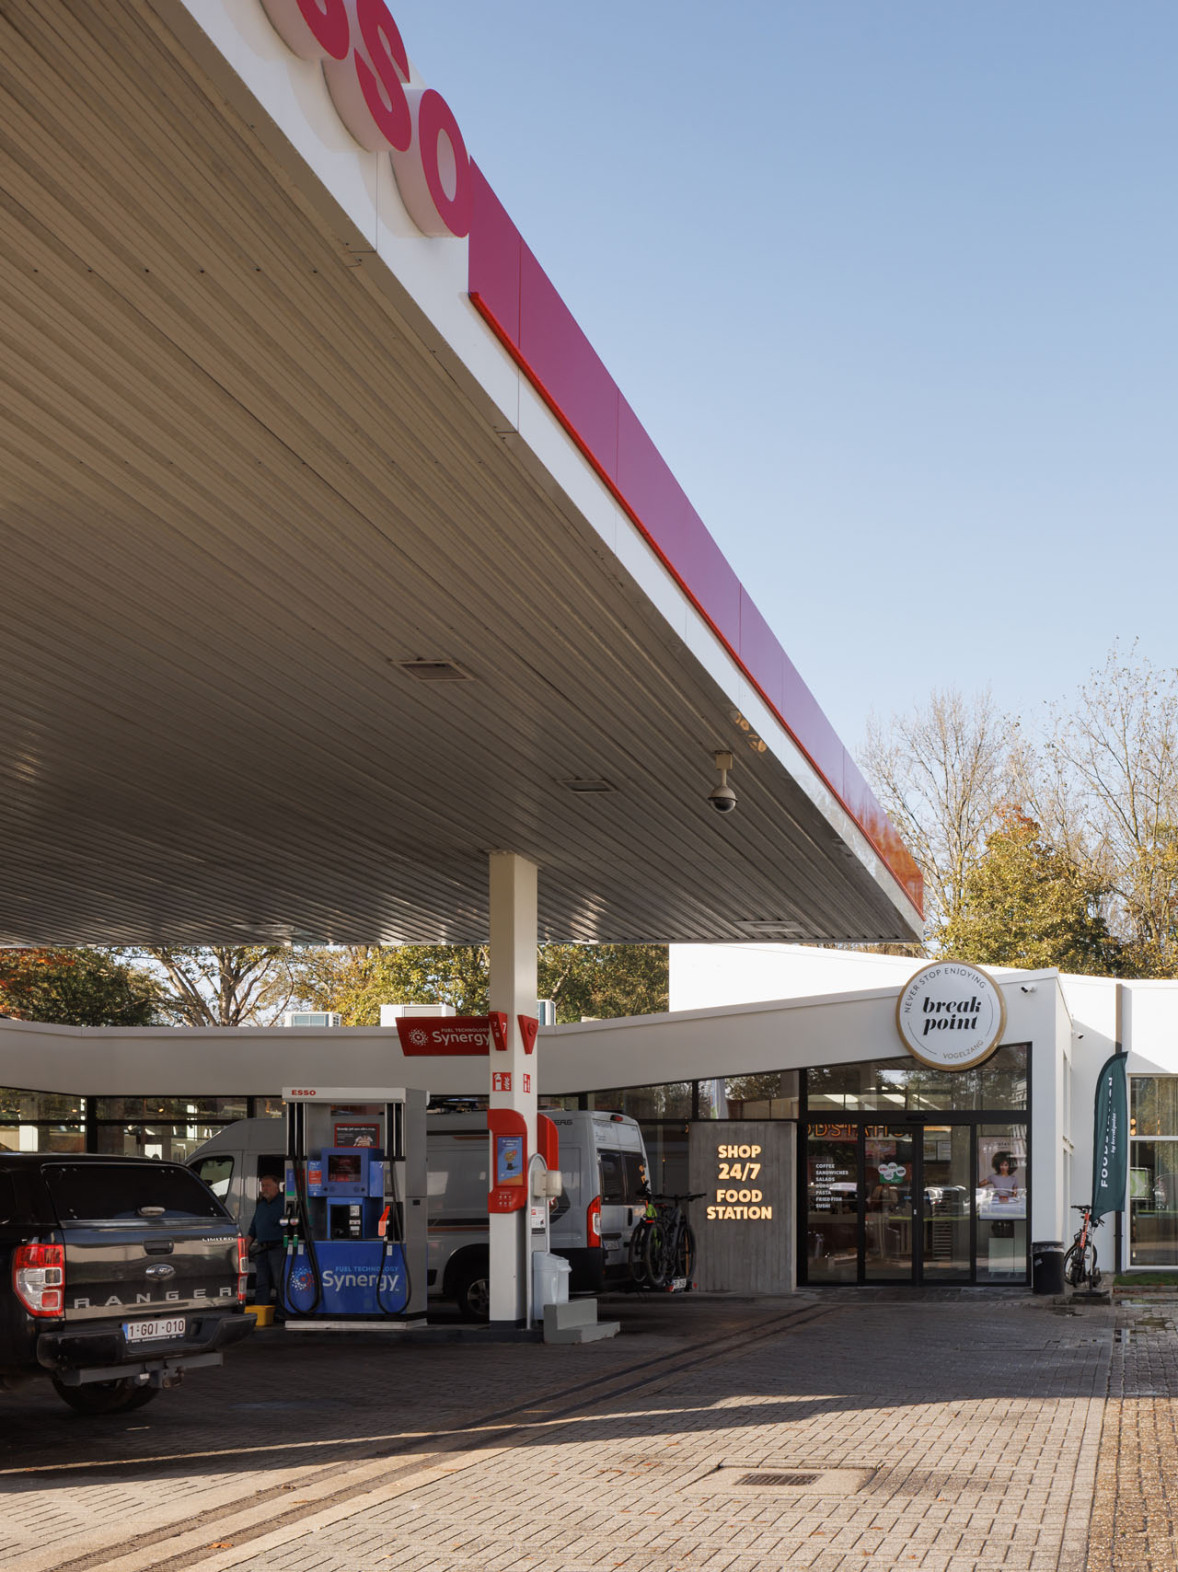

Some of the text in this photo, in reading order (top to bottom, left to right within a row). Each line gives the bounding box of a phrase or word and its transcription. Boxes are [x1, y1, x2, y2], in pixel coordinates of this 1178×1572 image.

[904, 967, 987, 1013] NEVER STOP ENJOYING
[923, 996, 981, 1013] break
[502, 1022, 507, 1034] 7
[923, 1014, 978, 1036] point
[943, 1040, 984, 1060] VOGELZANG
[718, 1144, 762, 1158] SHOP
[718, 1162, 761, 1181] 24/7
[716, 1189, 763, 1203] FOOD
[706, 1206, 772, 1220] STATION
[322, 1270, 399, 1292] Synergy
[74, 1287, 232, 1309] RANGER
